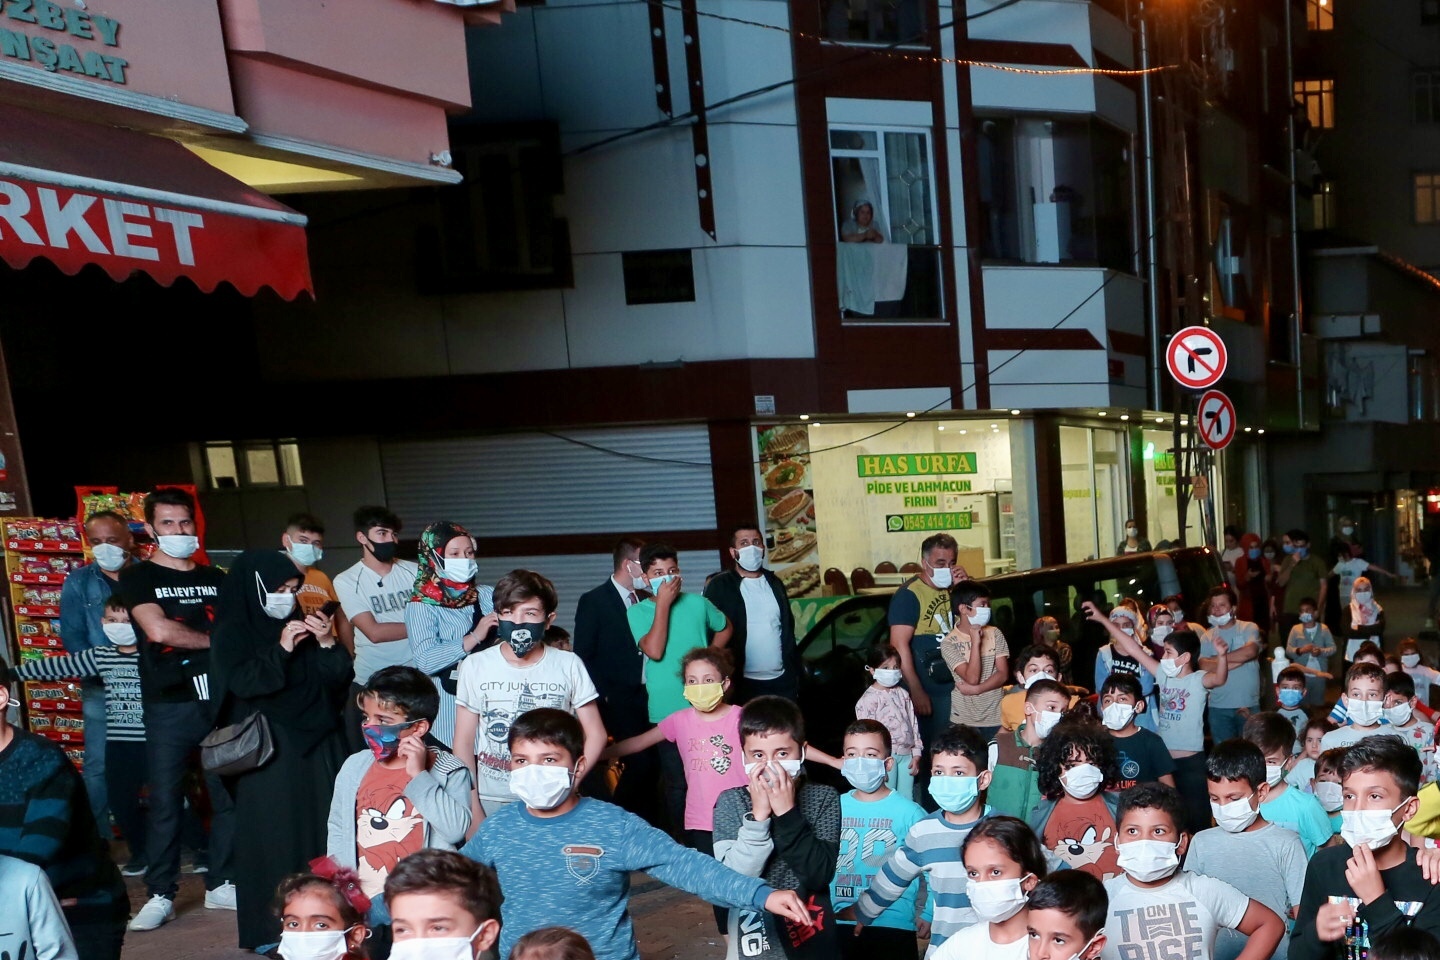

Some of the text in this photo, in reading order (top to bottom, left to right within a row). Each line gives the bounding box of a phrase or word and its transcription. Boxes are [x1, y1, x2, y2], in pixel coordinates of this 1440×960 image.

[863, 453, 972, 476] HAS URFA
[866, 480, 972, 494] PİDE VE LAHMACUN
[903, 513, 970, 530] 0545 414 21 63
[195, 585, 218, 597] THAT
[480, 681, 567, 693] CITY JUNCTION
[1146, 904, 1167, 918] ON
[1114, 901, 1203, 943] THE
